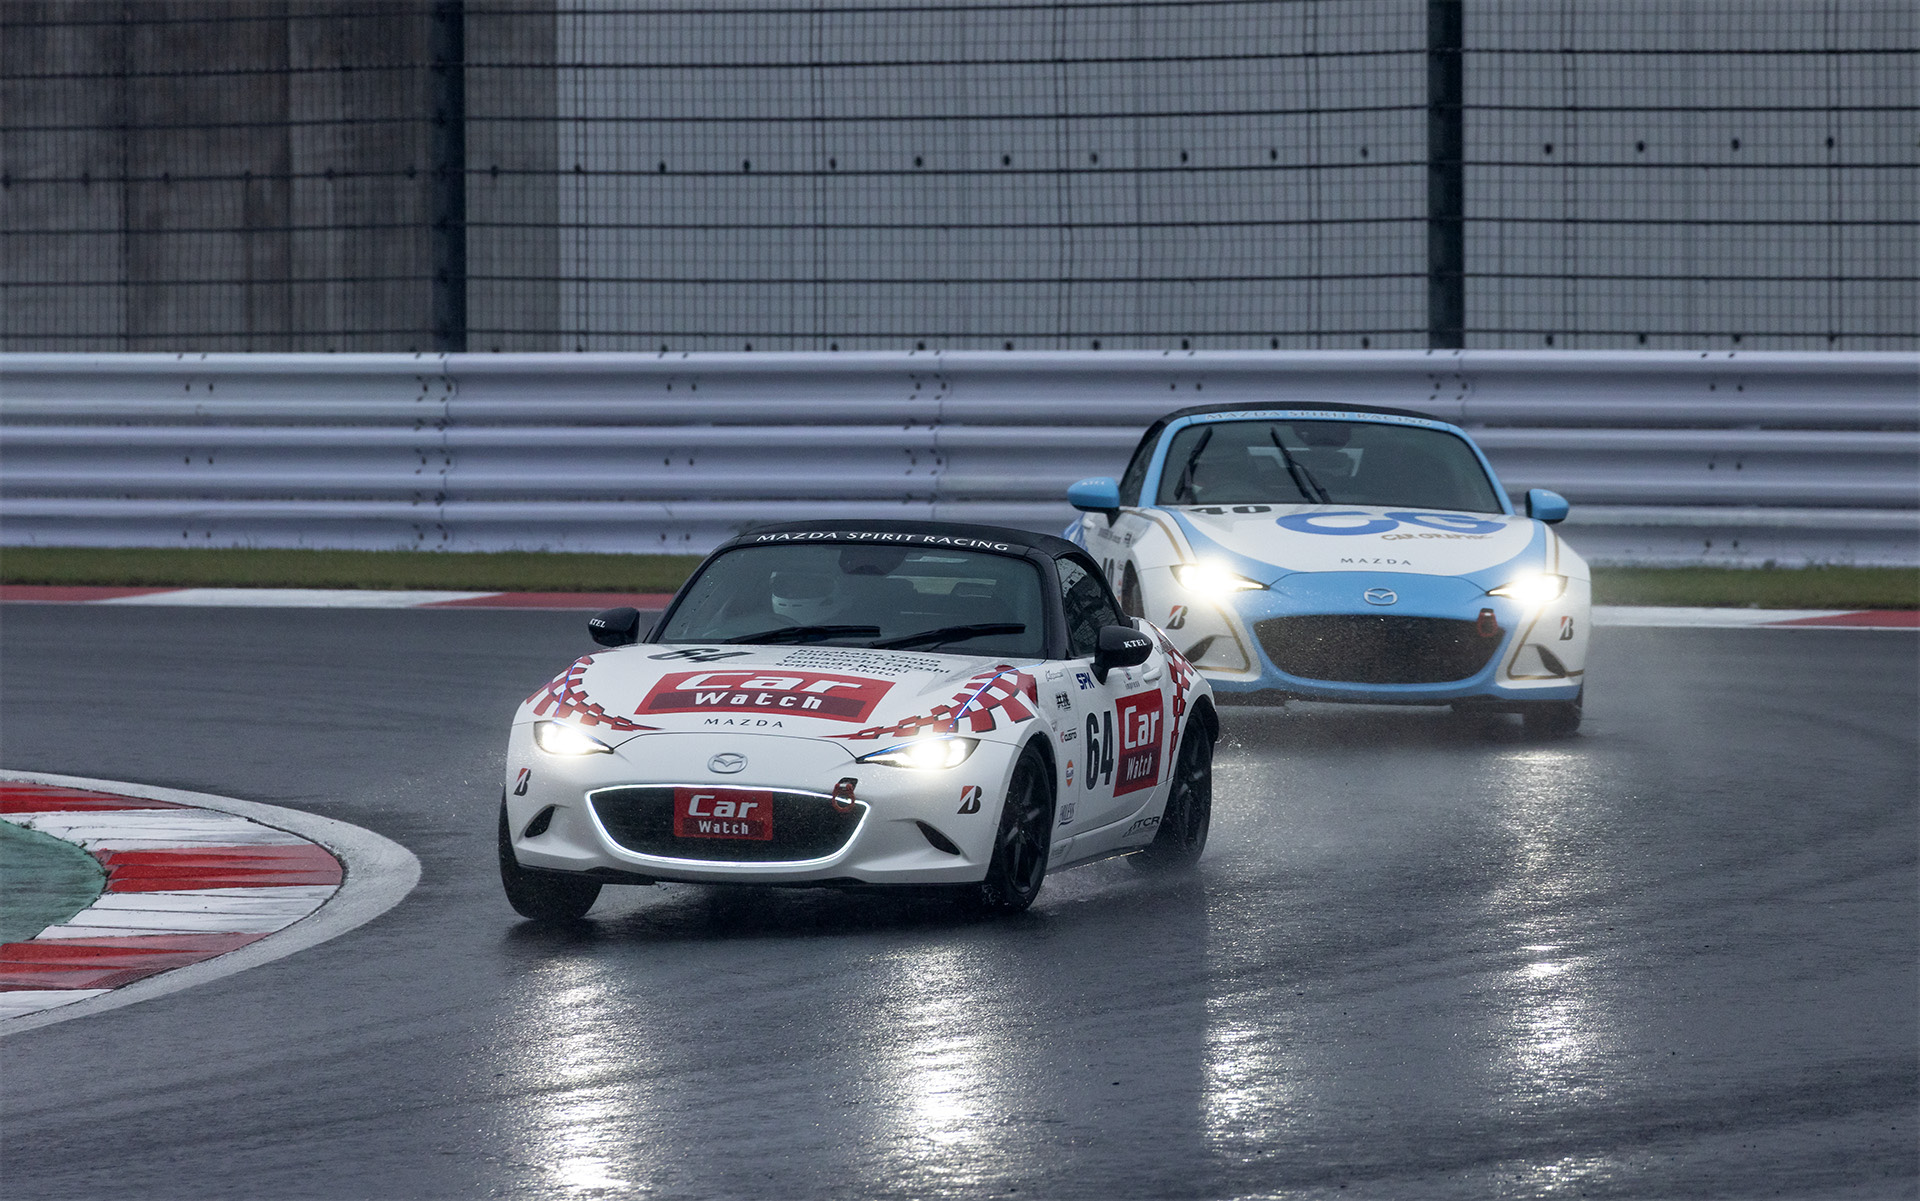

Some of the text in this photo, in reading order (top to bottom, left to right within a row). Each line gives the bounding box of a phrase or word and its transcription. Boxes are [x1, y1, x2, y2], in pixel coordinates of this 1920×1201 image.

[1189, 505, 1272, 515] 40
[1275, 511, 1507, 536] CG
[756, 532, 1009, 551] MAZDA SPIRIT RACING
[1340, 557, 1412, 566] MAZDA
[1123, 639, 1147, 648] KTEL
[647, 648, 754, 663] 64
[675, 672, 863, 693] Car
[1076, 672, 1095, 690] SPK
[694, 692, 824, 710] Watch
[703, 718, 784, 728] MAZDA
[1124, 705, 1160, 750] Car
[1086, 710, 1114, 790] 64
[1126, 752, 1153, 781] Watch
[688, 794, 759, 819] Car
[698, 820, 749, 835] Watch
